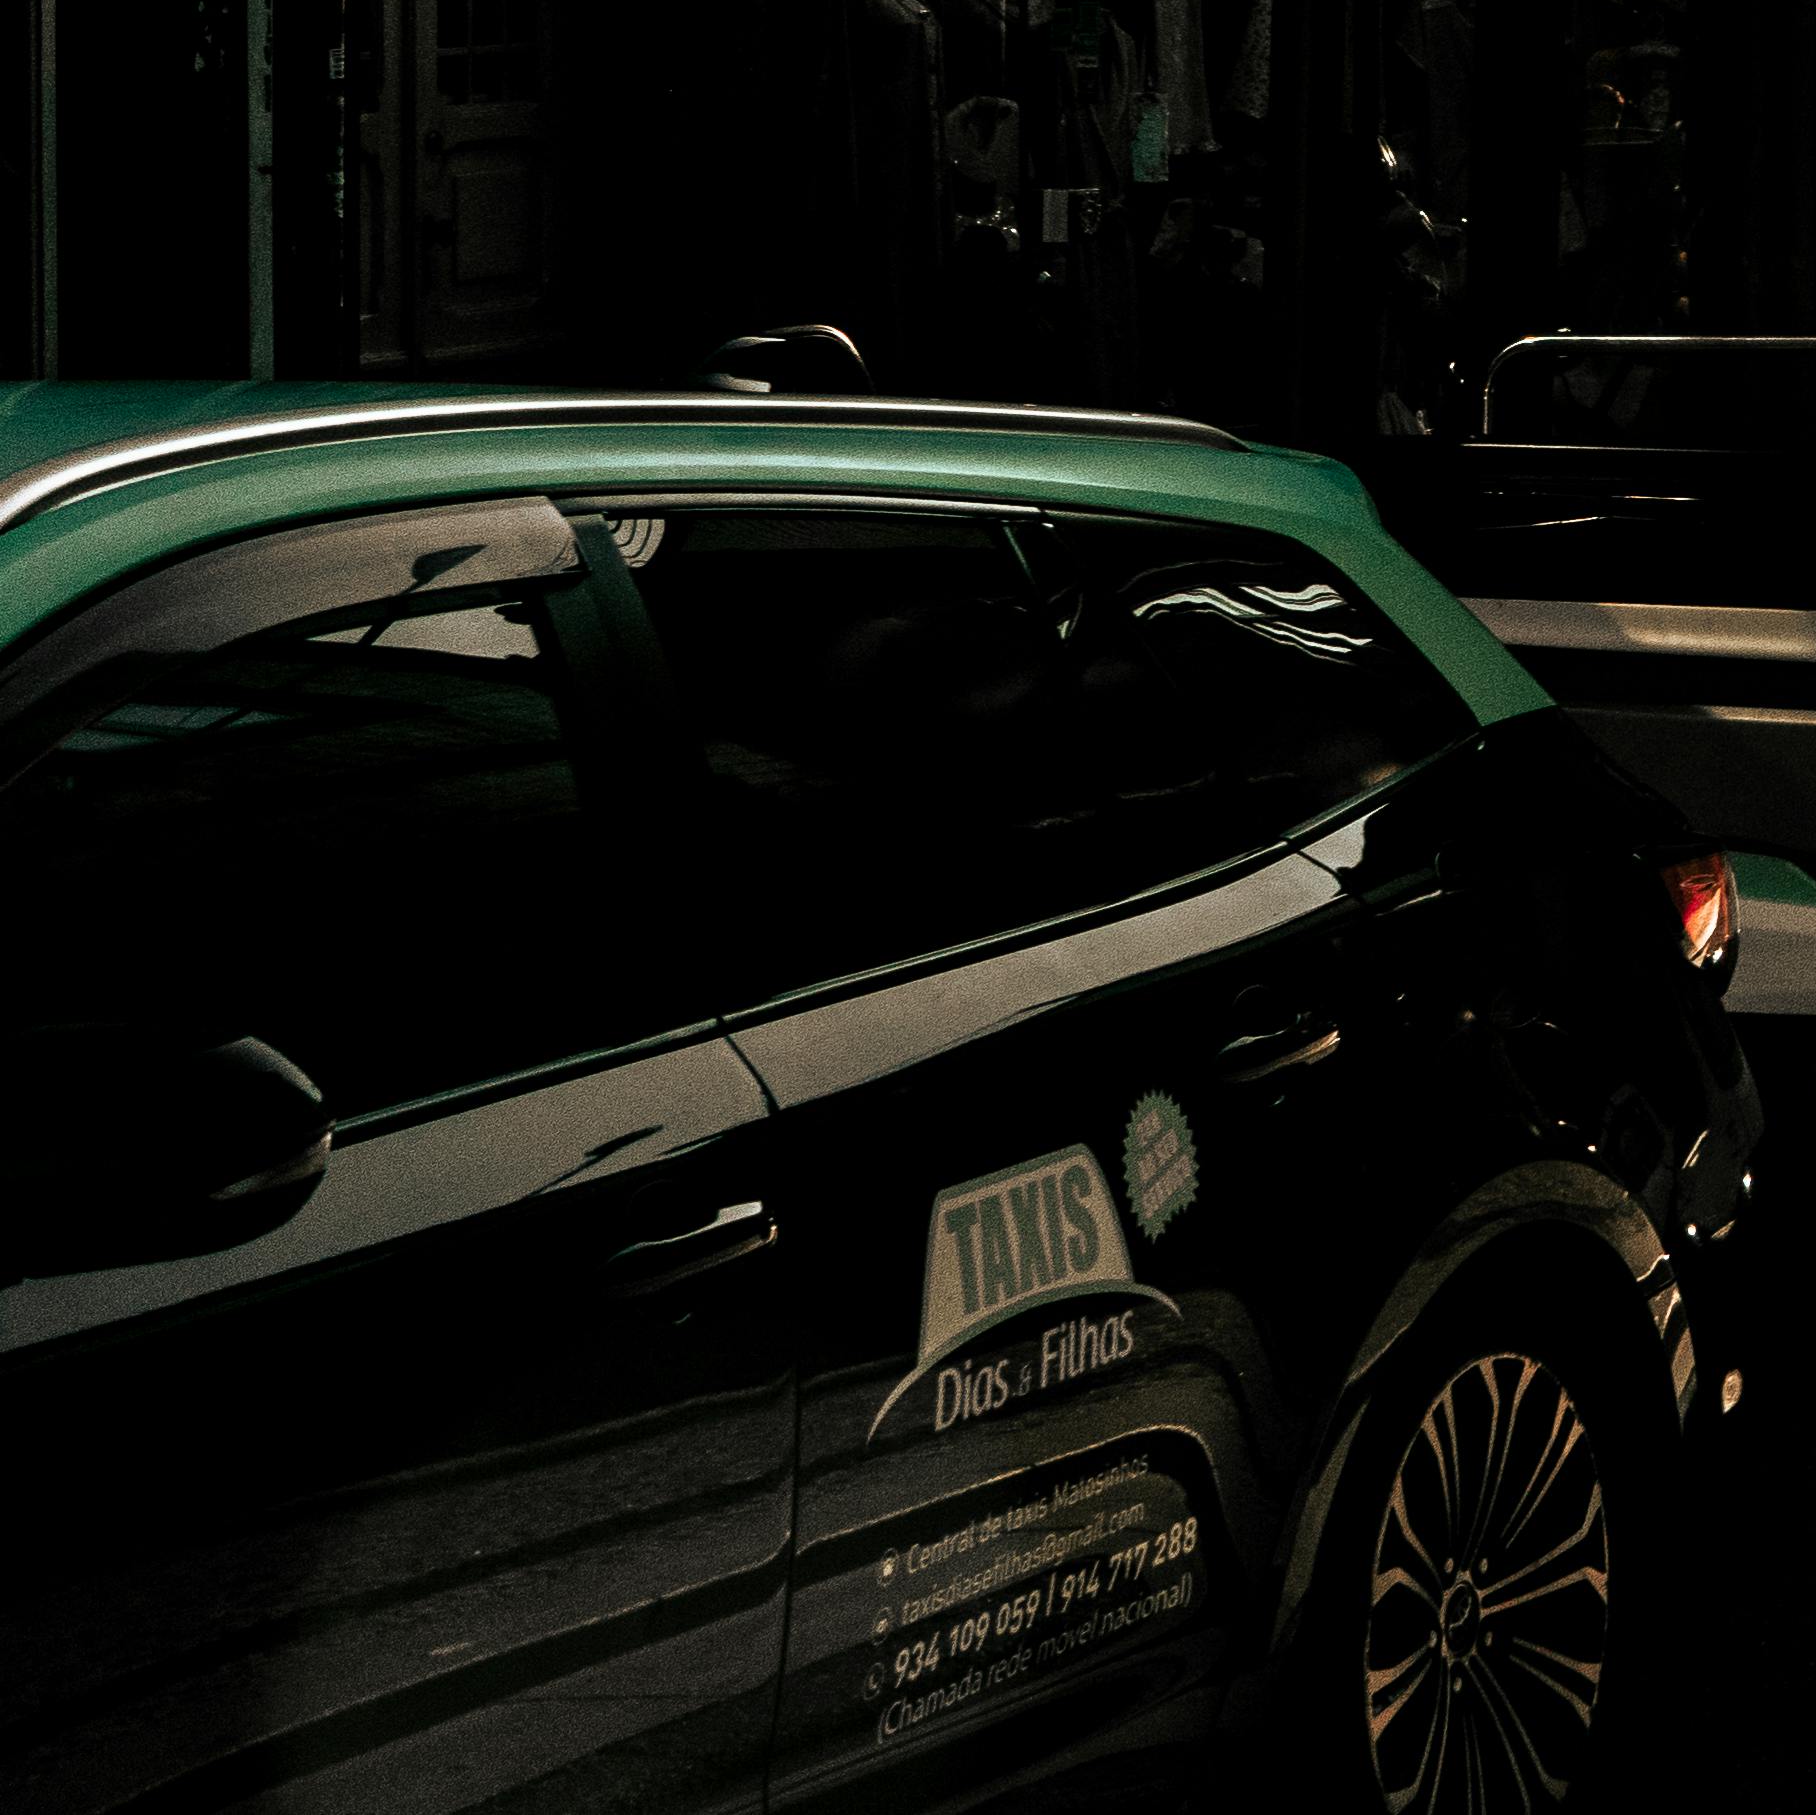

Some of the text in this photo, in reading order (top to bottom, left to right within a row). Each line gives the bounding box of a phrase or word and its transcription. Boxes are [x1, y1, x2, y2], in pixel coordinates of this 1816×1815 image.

[945, 1166, 1099, 1315] TAXIS
[933, 1358, 1010, 1433] Dias
[1040, 1309, 1134, 1389] Filhas
[908, 1518, 976, 1575] Central
[977, 1511, 1001, 1545] de
[1053, 1453, 1150, 1514] Matosinhos
[895, 1631, 941, 1689] 934
[949, 1611, 991, 1657] 109
[995, 1588, 1042, 1635] 059
[1060, 1559, 1101, 1614] 914
[1107, 1539, 1151, 1592] 717
[1152, 1515, 1199, 1568] 288
[878, 1666, 984, 1745] (Chamada
[986, 1638, 1033, 1687] rede
